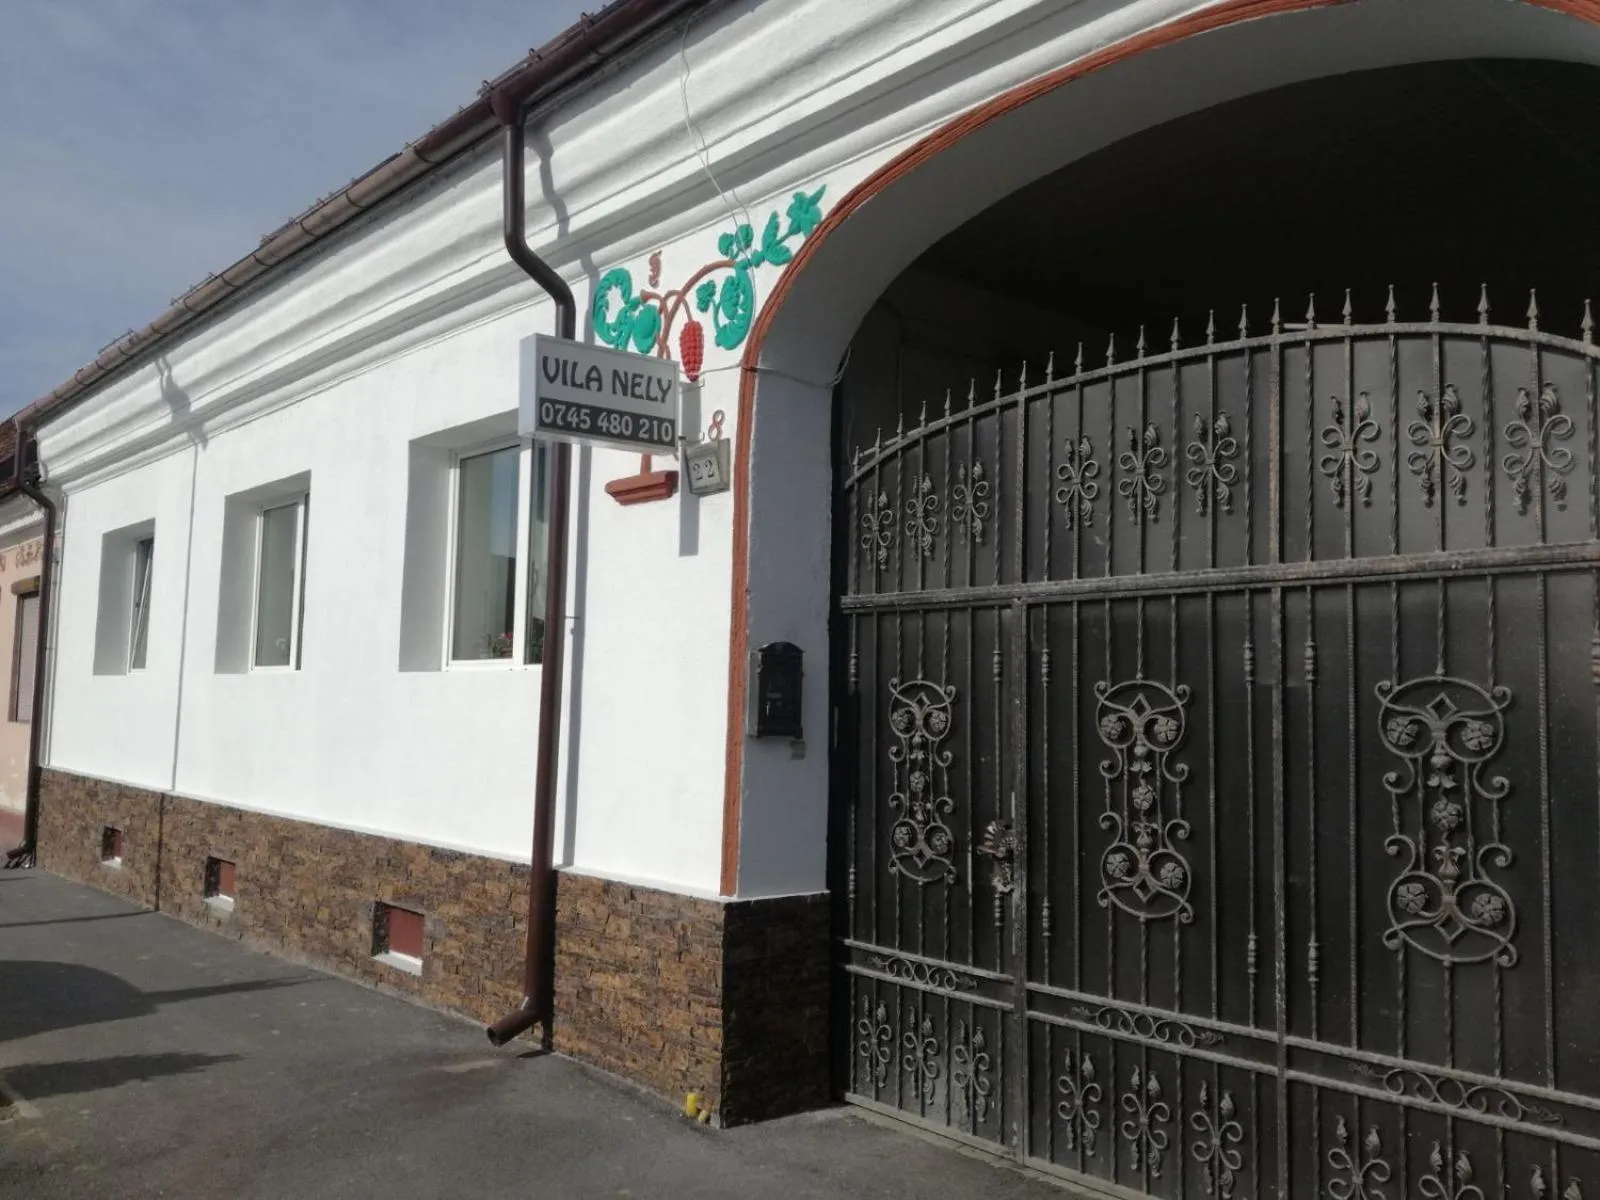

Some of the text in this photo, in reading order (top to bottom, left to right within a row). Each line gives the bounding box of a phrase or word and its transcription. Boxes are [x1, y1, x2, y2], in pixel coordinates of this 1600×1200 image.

[542, 356, 672, 404] VILA NELY
[541, 402, 673, 442] 0745 480 210
[692, 459, 714, 480] 22
